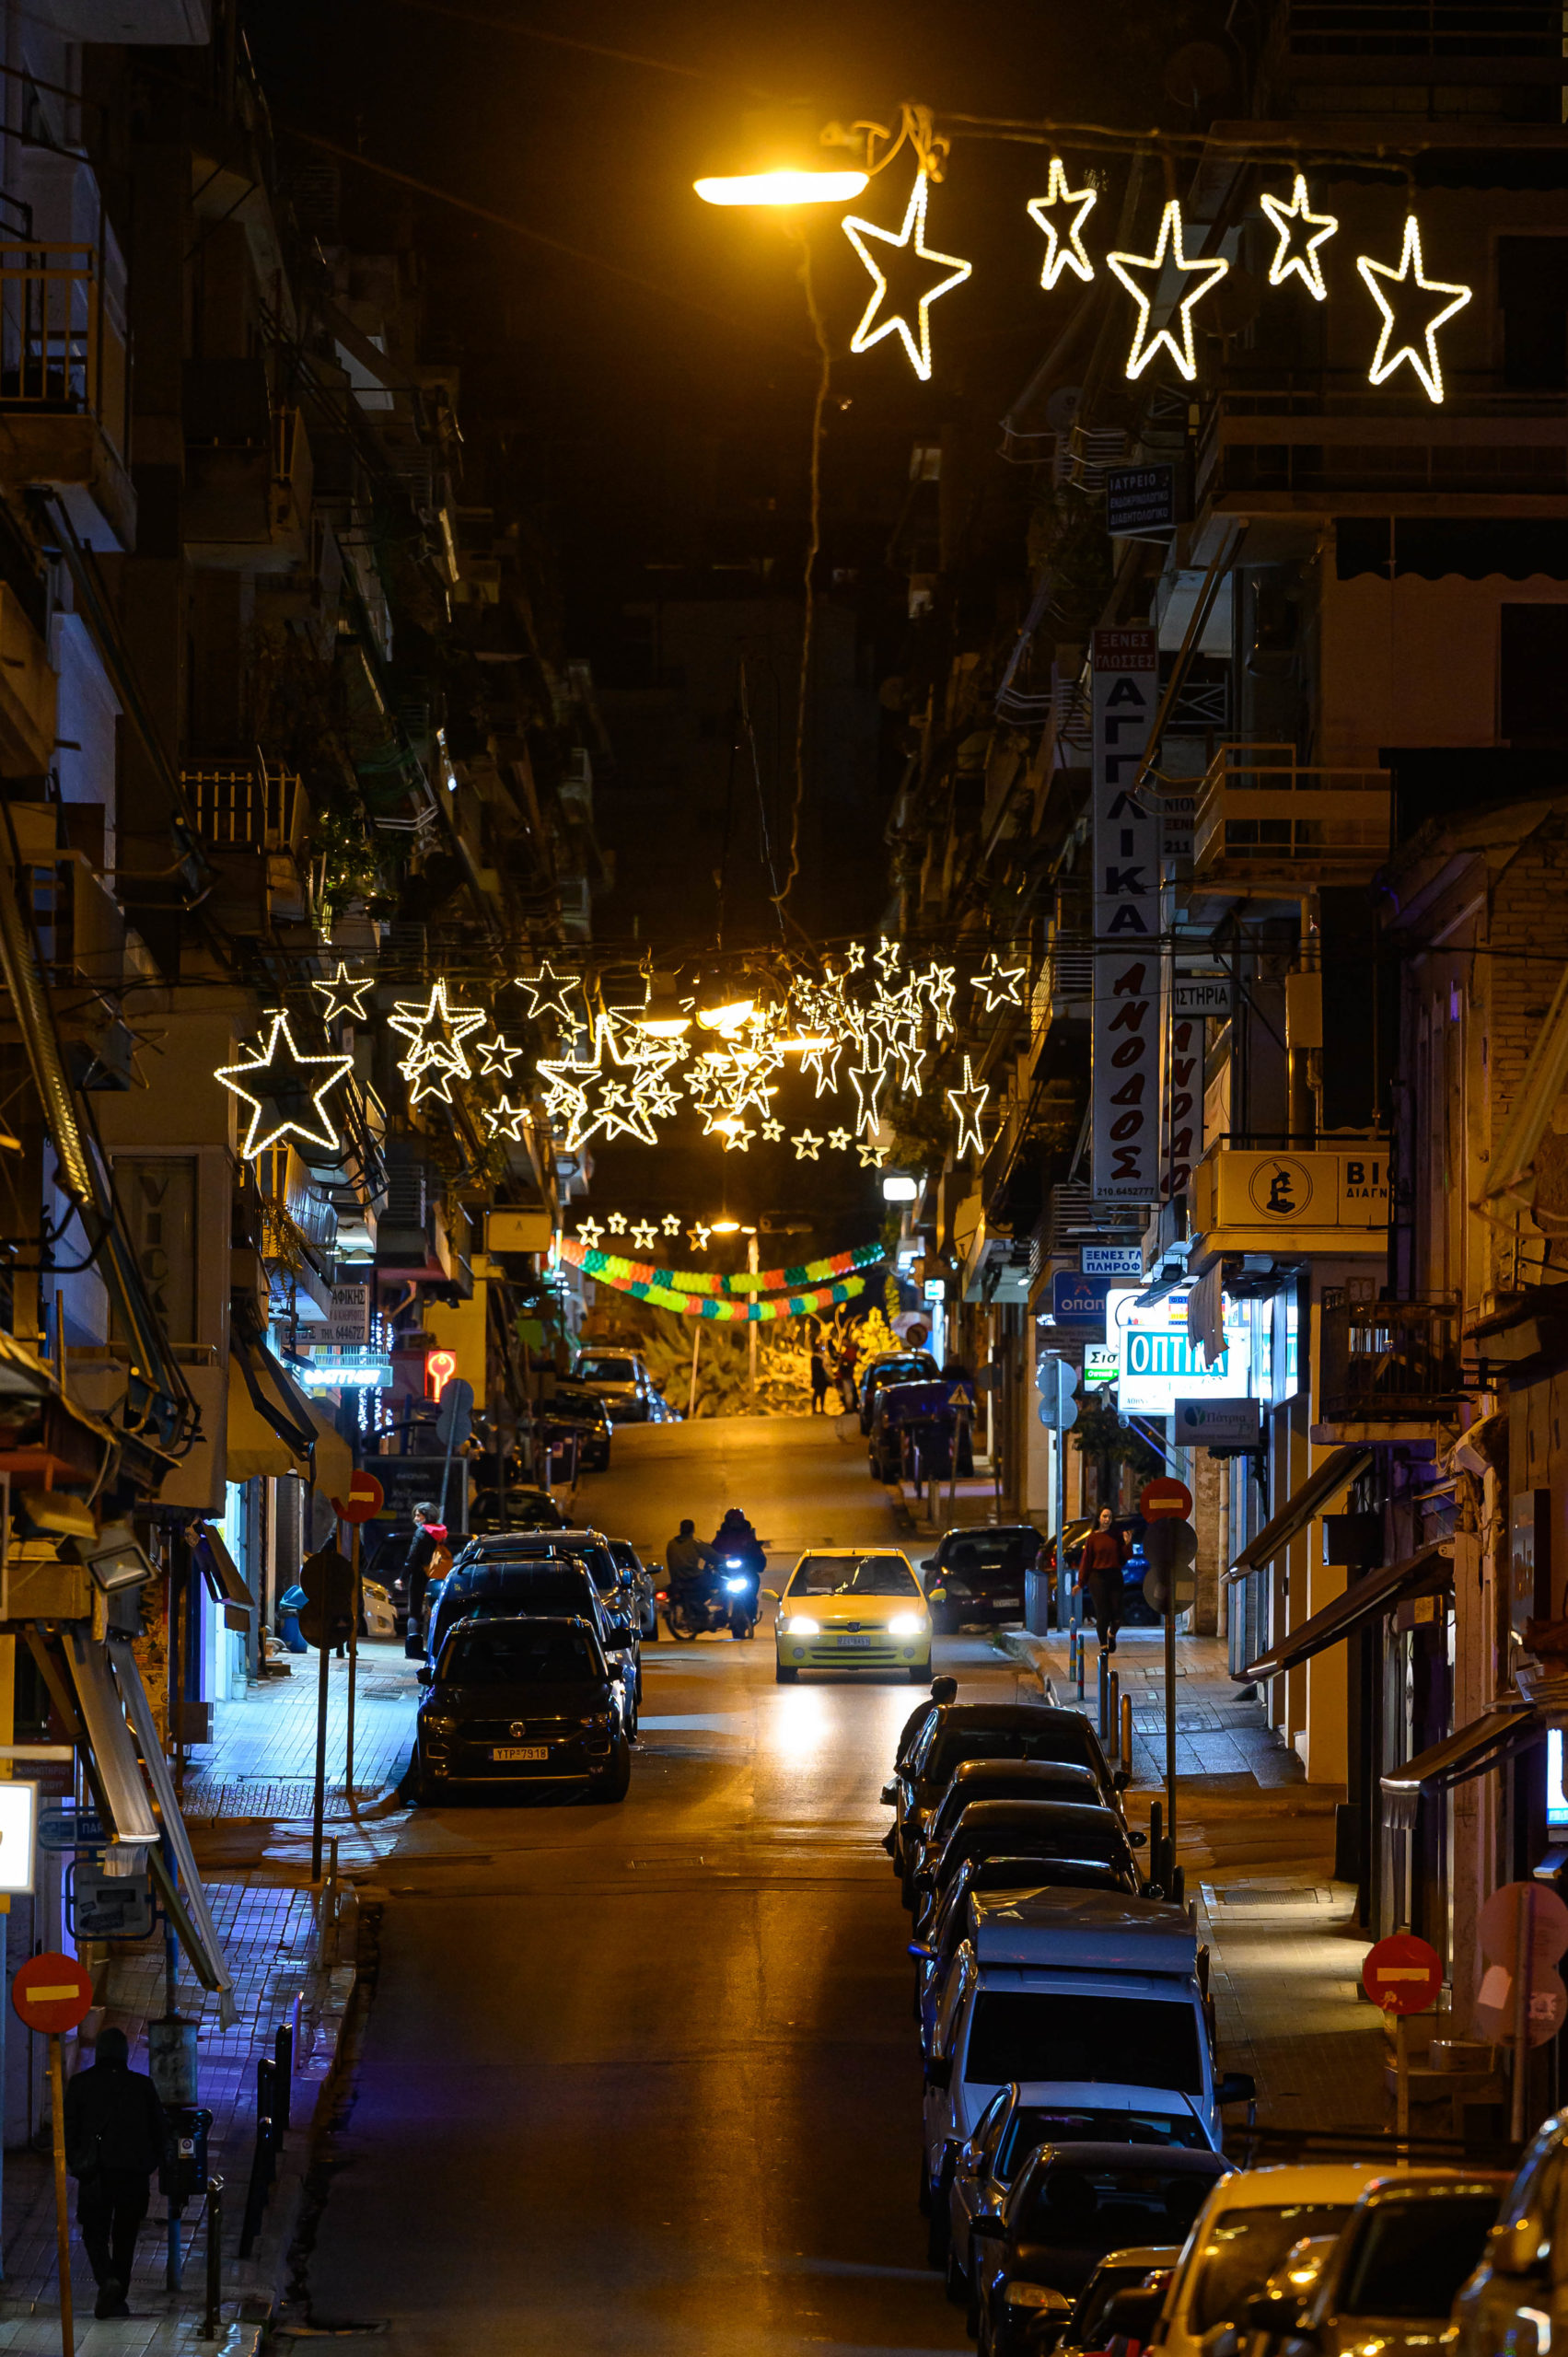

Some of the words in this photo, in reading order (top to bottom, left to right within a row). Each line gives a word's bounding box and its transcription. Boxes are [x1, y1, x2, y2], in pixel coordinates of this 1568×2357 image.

[1109, 473, 1156, 492] ΙΑΤΡΕΙΟ
[1099, 633, 1149, 648] ΞΕΝΕΣ
[1096, 655, 1156, 669] ΓΛΩΣΣΕΣ
[1105, 678, 1148, 934] ΑΓΓΛΙΚΑ
[1165, 841, 1191, 853] 211
[1176, 987, 1228, 1004] ΙΣΤΗΡΙΑ
[1108, 962, 1150, 1180] ΑΝΟΔΟΣ
[1097, 1187, 1155, 1196] 210.6452777
[140, 1176, 169, 1334] VICK
[1086, 1250, 1125, 1260] ΞΕΝΕΣ
[1086, 1262, 1141, 1271] ΠΛΗΡΟΦ
